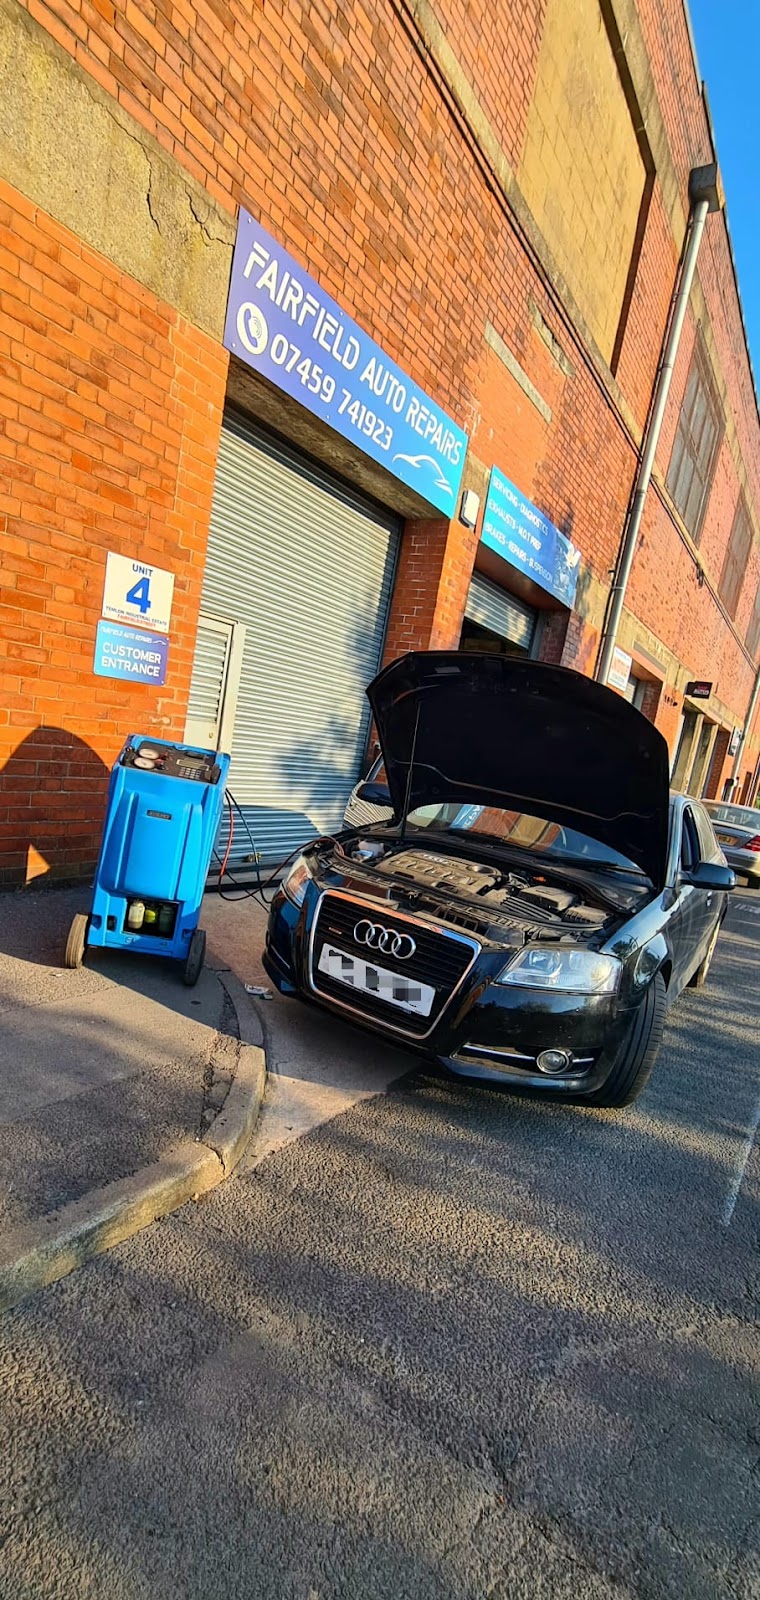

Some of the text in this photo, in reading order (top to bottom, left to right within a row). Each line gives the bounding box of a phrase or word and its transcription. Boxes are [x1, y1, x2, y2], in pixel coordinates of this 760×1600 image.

[243, 241, 463, 466] FAIRFIELD AUTO REPAIRS
[269, 333, 393, 451] 07459 741923
[489, 500, 516, 528] EXHAUSTS
[492, 477, 547, 535] SERVICING DIAGNOSTICS
[486, 523, 552, 583] BRAKES REPAIRS SUSPENSION
[132, 563, 153, 577] UNIT
[126, 577, 151, 614] 4
[126, 611, 150, 621] INDUSTRIAL
[101, 655, 160, 677] ENTRANCE
[102, 642, 161, 664] CUSTOMER
